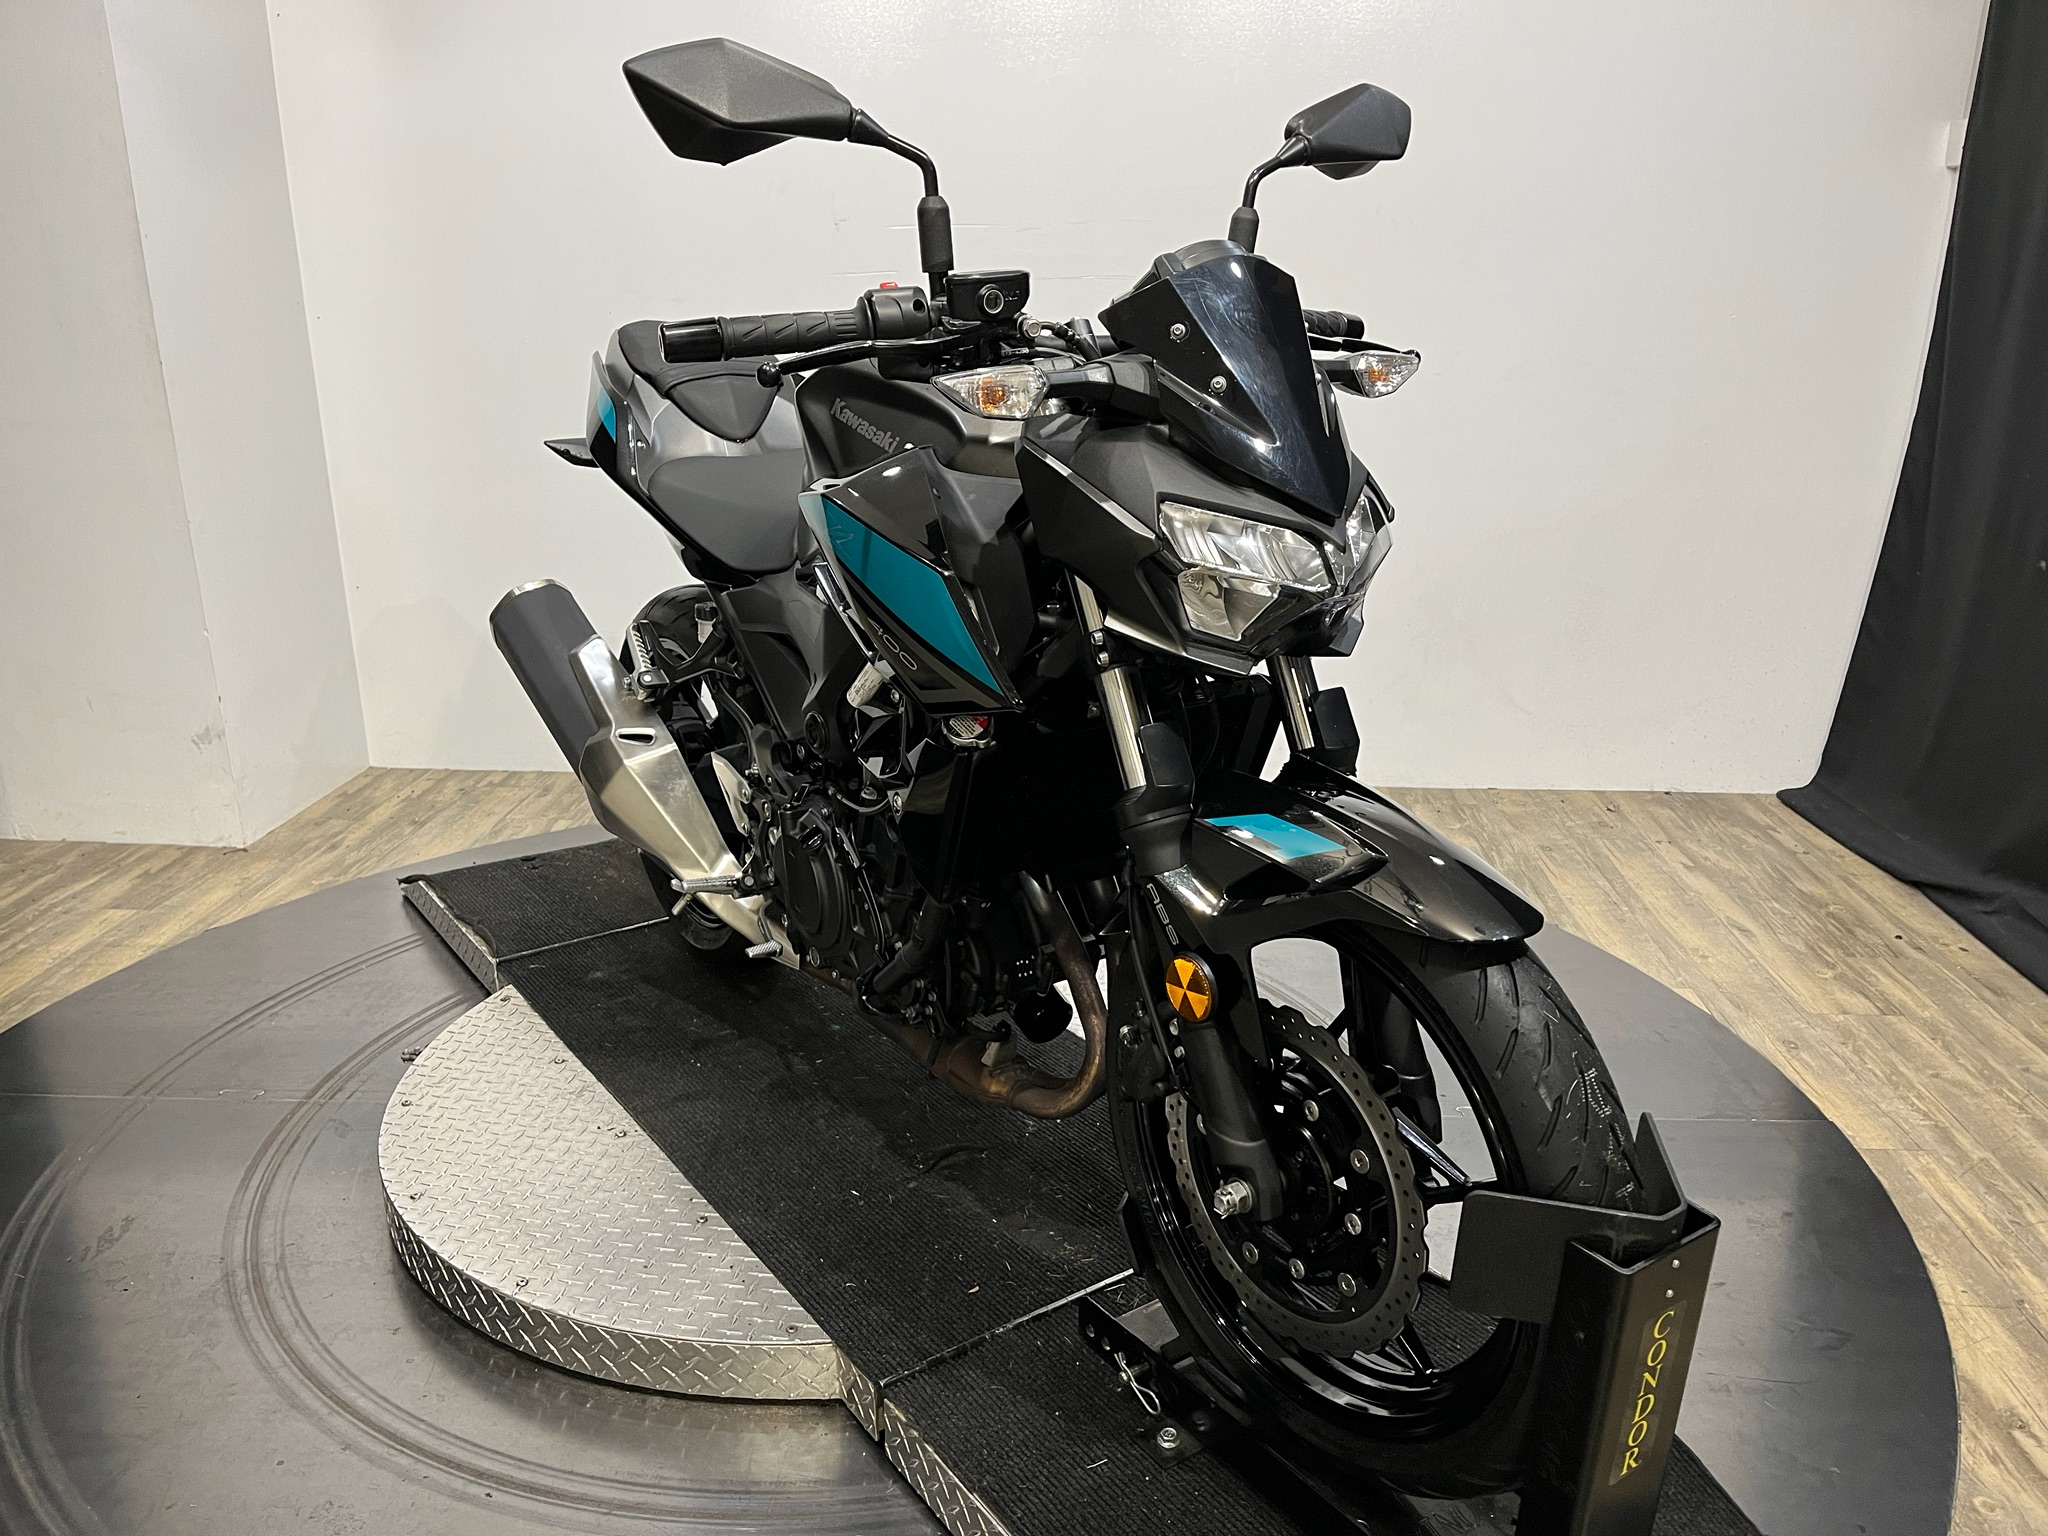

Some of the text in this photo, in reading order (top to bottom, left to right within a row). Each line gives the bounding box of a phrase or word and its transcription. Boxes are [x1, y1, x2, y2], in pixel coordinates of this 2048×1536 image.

[830, 397, 900, 453] Kawasaki
[867, 617, 918, 671] 400
[1146, 883, 1180, 946] ABS
[1619, 1309, 1675, 1477] CONDOR
